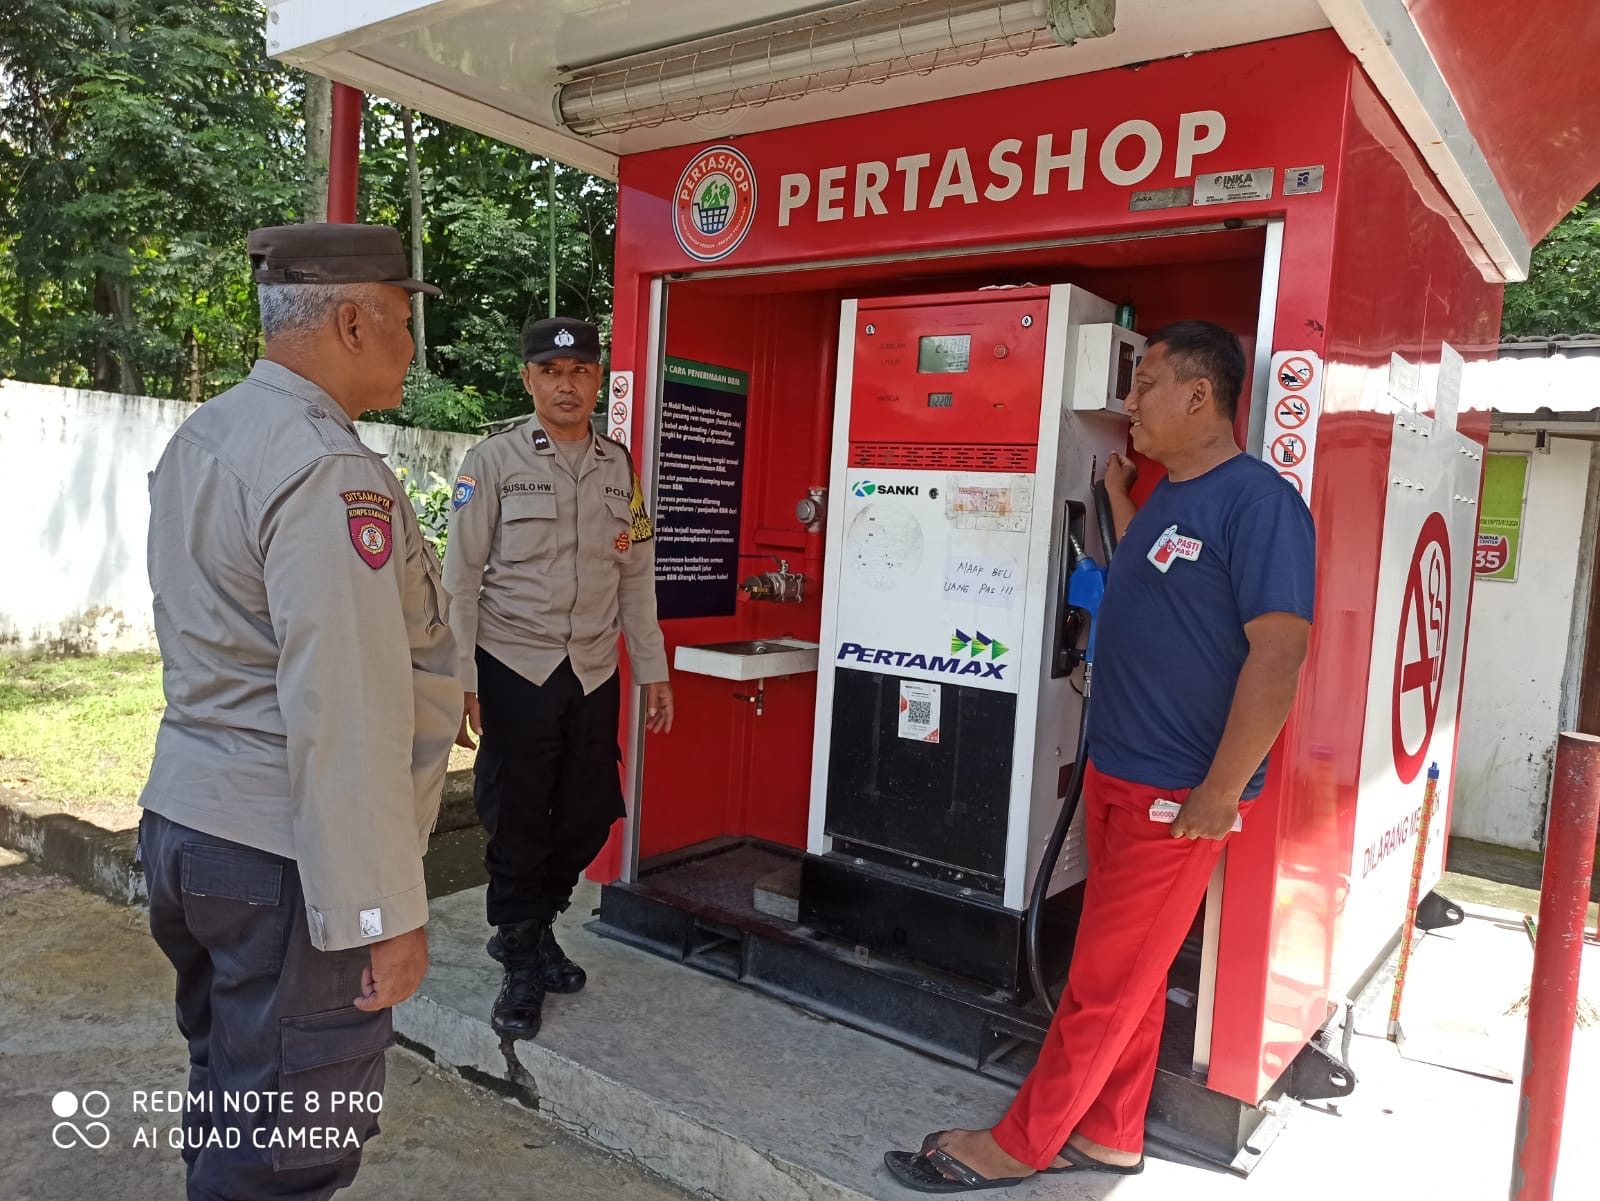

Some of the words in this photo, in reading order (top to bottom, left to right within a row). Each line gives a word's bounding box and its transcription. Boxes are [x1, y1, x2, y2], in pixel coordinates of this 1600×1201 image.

[778, 110, 1226, 227] PERTASHOP
[680, 155, 749, 200] PERTASHOP
[1223, 173, 1254, 185] INKA
[669, 365, 685, 375] CARA
[688, 370, 726, 382] PENERIMAAN
[502, 483, 536, 494] SUSILO
[537, 484, 552, 492] HW
[877, 484, 919, 496] SANKI
[344, 492, 390, 510] DITSAMAPTA
[1175, 548, 1194, 556] PAS!
[1176, 538, 1200, 552] PASTI
[1475, 550, 1500, 568] 35
[956, 562, 984, 576] MAAF
[837, 642, 1008, 680] PERTAMAX
[1363, 816, 1409, 879] DILARANG
